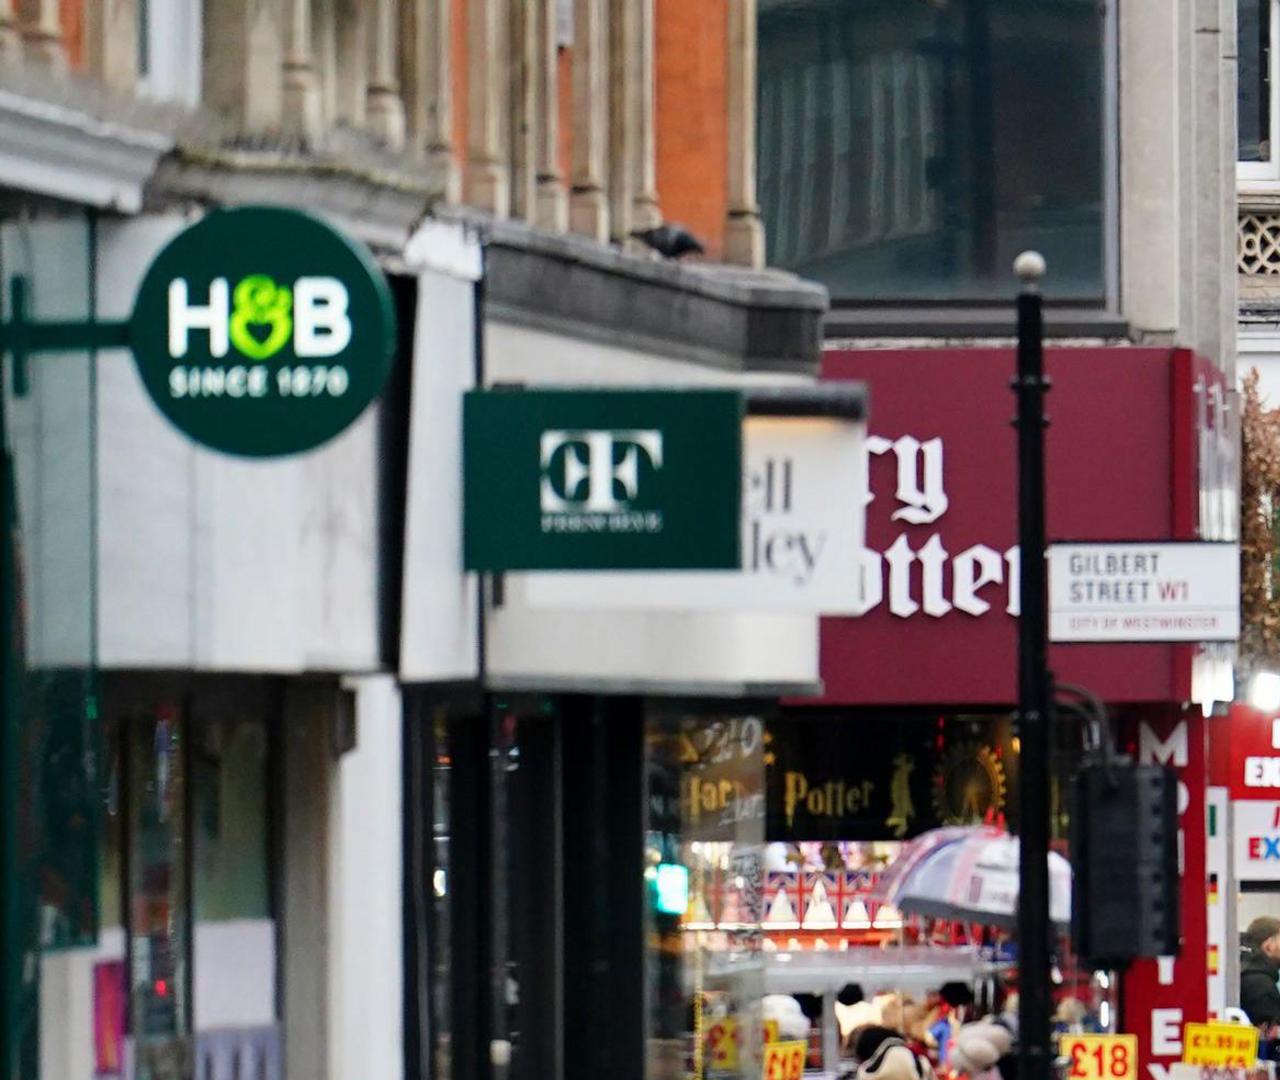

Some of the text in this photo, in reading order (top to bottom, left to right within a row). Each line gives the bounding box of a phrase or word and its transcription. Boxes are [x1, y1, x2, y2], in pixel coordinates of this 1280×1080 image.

[168, 274, 351, 360] H&B
[169, 365, 349, 398] SINCE 1870
[1069, 554, 1160, 574] GILBERT
[1069, 581, 1190, 602] STREET W1
[1070, 1042, 1129, 1078] £18
